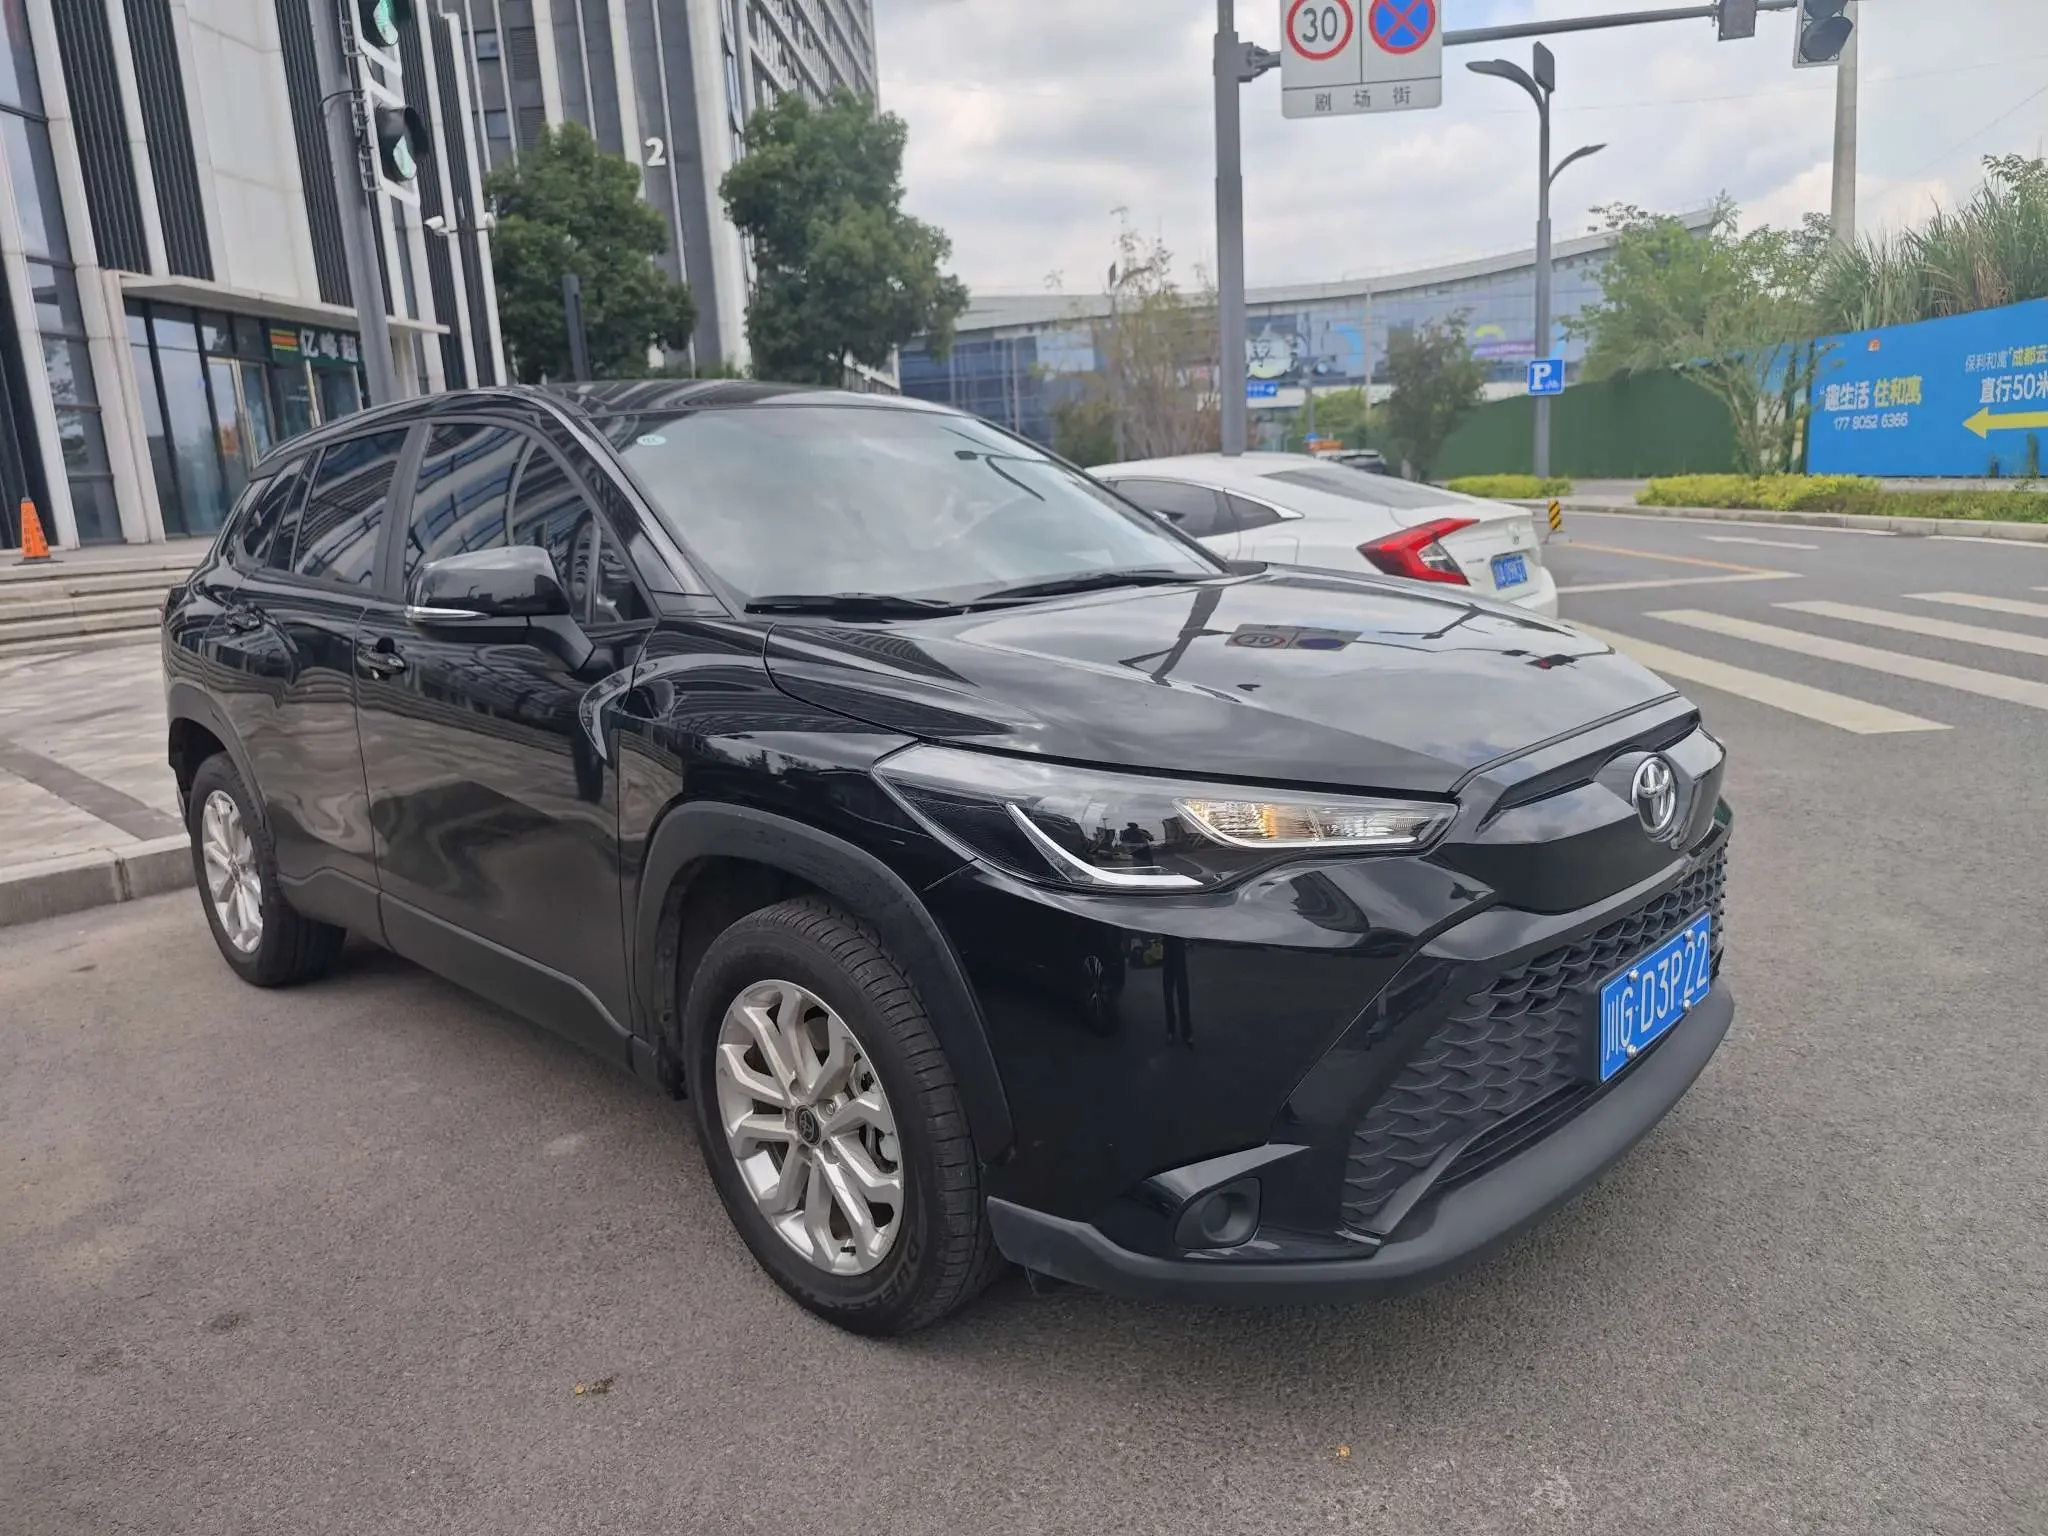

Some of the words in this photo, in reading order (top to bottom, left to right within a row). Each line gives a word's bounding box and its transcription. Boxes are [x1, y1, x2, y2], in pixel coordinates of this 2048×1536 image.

[1302, 6, 1338, 43] 30
[645, 136, 666, 166] 2
[1531, 361, 1552, 391] P
